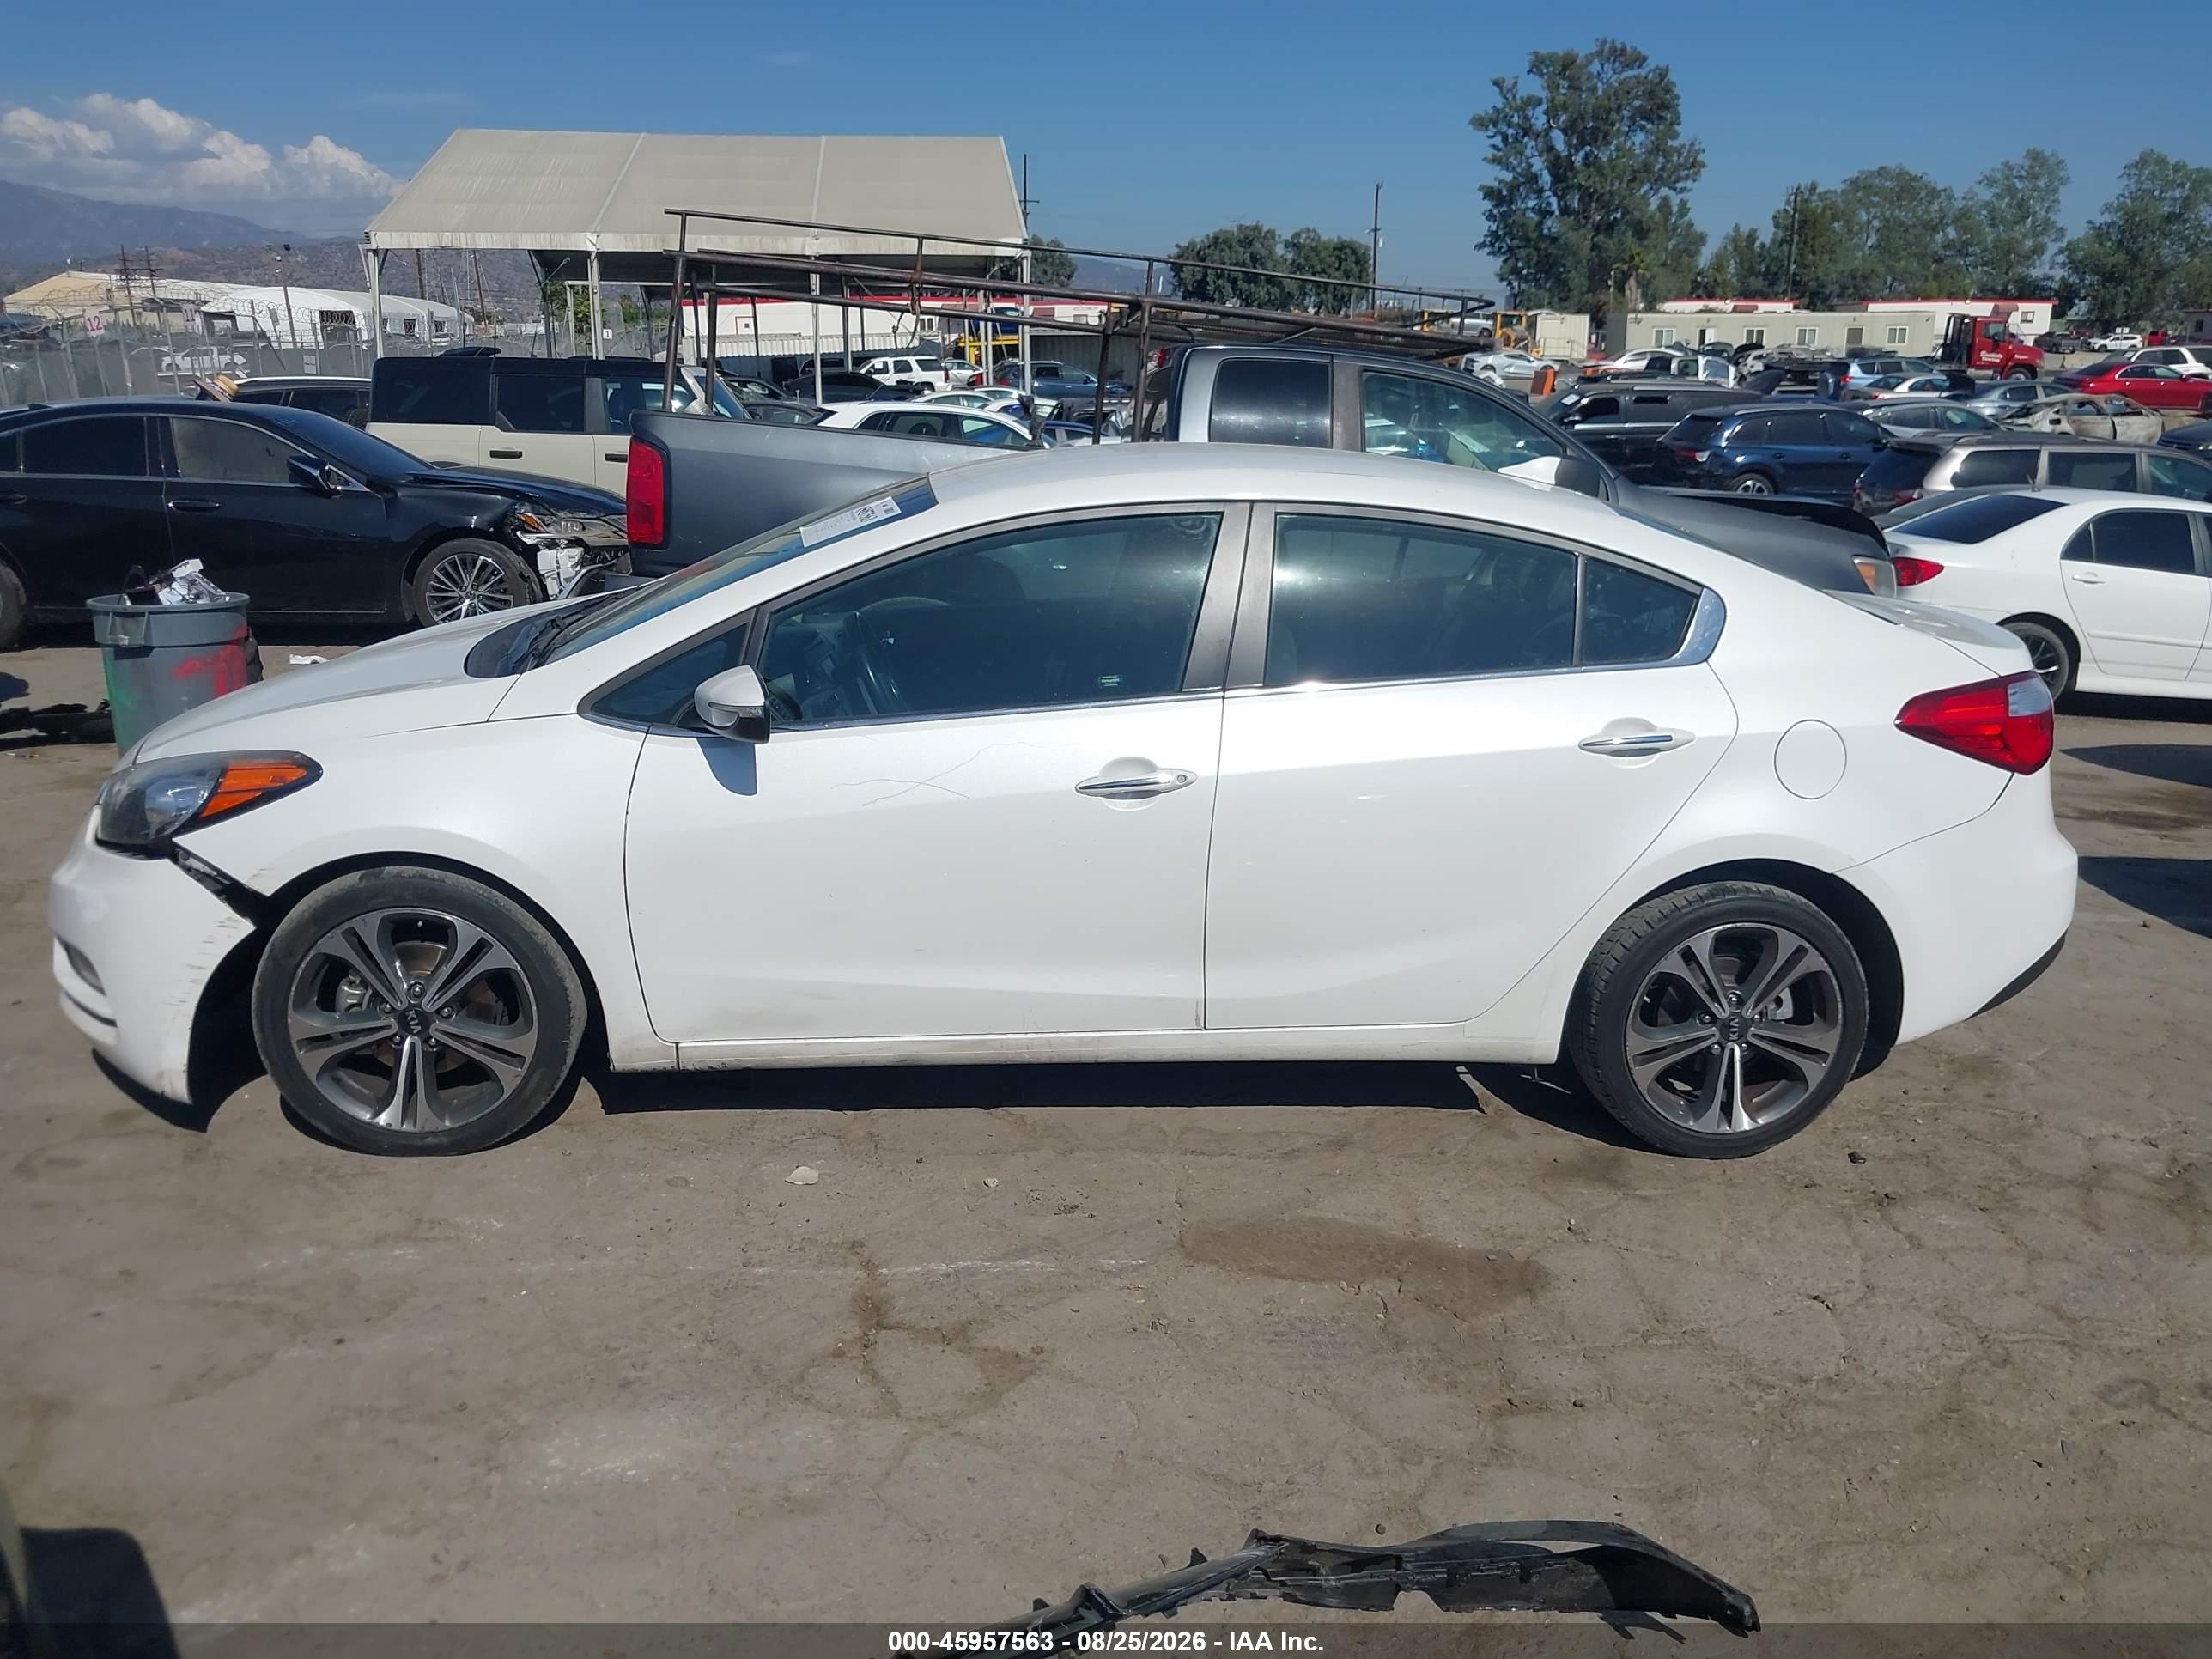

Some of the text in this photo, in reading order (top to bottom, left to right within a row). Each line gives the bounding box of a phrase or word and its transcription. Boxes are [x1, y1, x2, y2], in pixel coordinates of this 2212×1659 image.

[87, 315, 103, 332] 12
[405, 1009, 422, 1034] KIA
[1729, 1018, 1739, 1040] KIA
